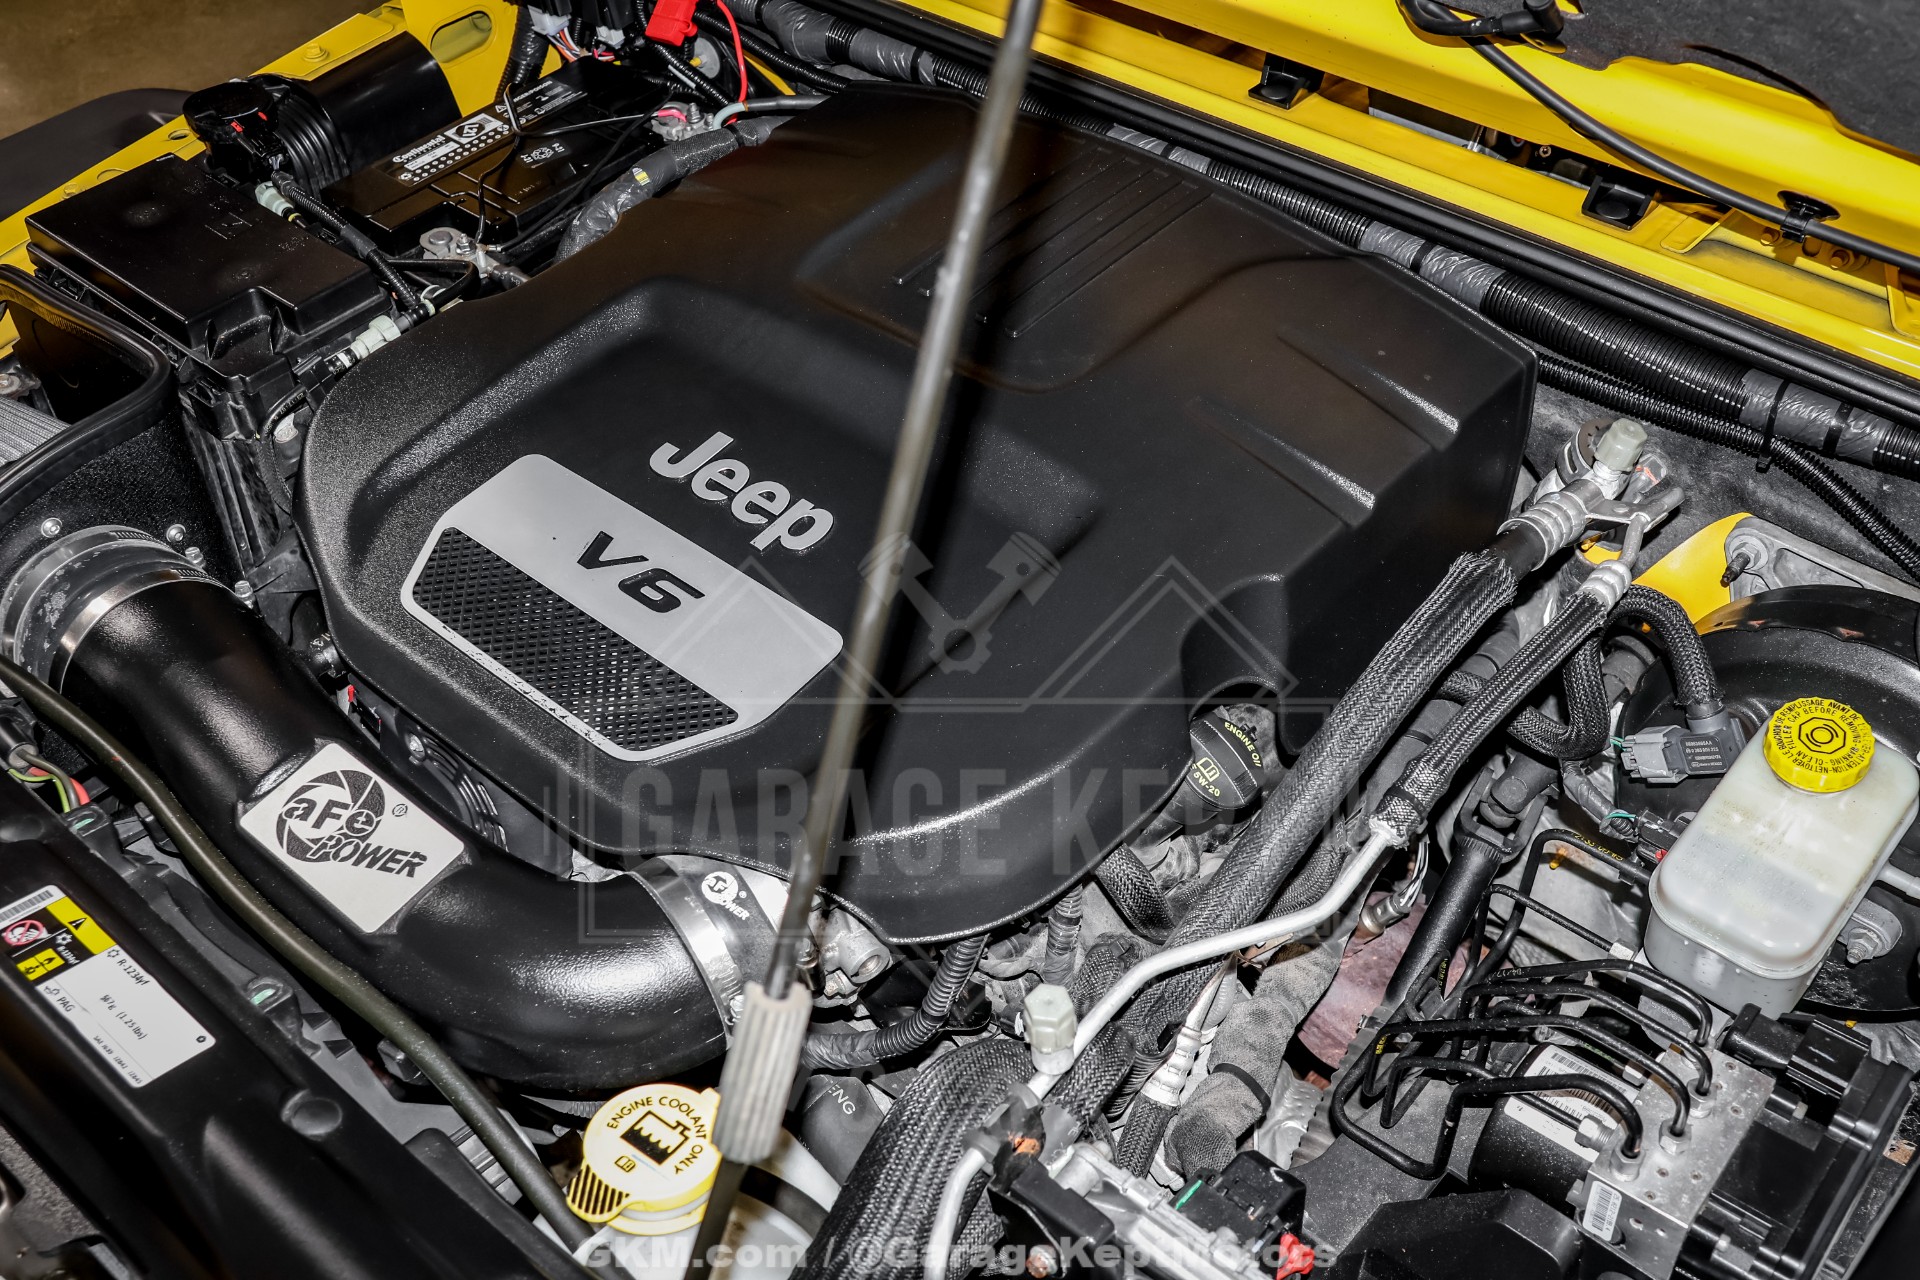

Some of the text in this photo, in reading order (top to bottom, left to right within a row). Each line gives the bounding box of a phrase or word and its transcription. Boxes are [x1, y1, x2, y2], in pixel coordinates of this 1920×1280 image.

[392, 134, 447, 163] Continental
[649, 431, 834, 551] Jeep
[576, 530, 706, 614] V6
[1780, 699, 1825, 718] REMPLISSAGE
[1827, 701, 1851, 714] AVANT
[1849, 713, 1860, 721] DE
[1787, 712, 1801, 723] CAP
[1802, 706, 1838, 717] BEFORE
[1224, 721, 1255, 752] ENGINE
[1782, 725, 1797, 750] FILLER
[1193, 771, 1221, 797] 5W-20
[283, 797, 378, 837] aFe
[306, 833, 428, 878] POWER
[116, 958, 151, 987] R-1234yf
[56, 996, 76, 1013] PAG
[606, 1095, 708, 1175] ENGINE COOLANT ONLY
